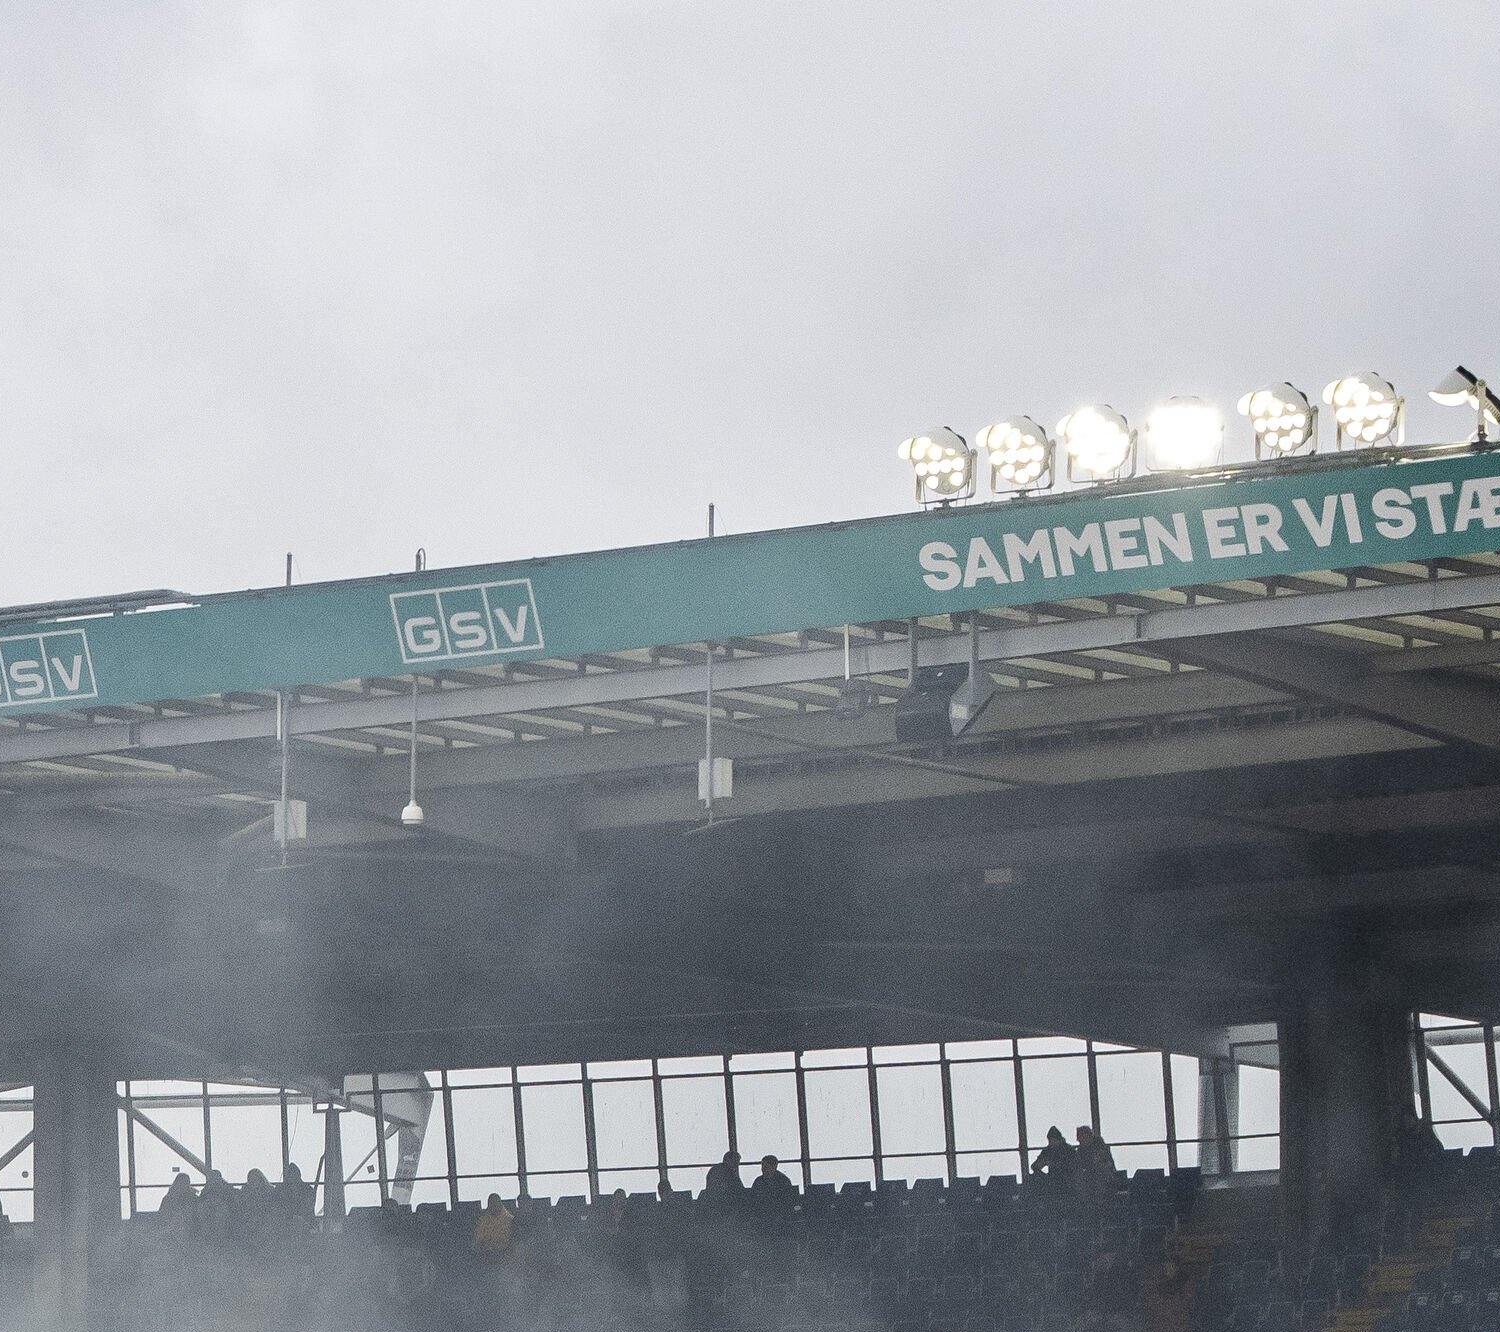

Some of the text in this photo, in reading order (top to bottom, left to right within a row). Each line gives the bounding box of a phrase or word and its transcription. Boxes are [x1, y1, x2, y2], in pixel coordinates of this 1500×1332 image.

[918, 512, 1194, 592] SAMMEN
[1205, 503, 1286, 561] ER
[1302, 493, 1363, 548] VI
[404, 605, 531, 655] GSV
